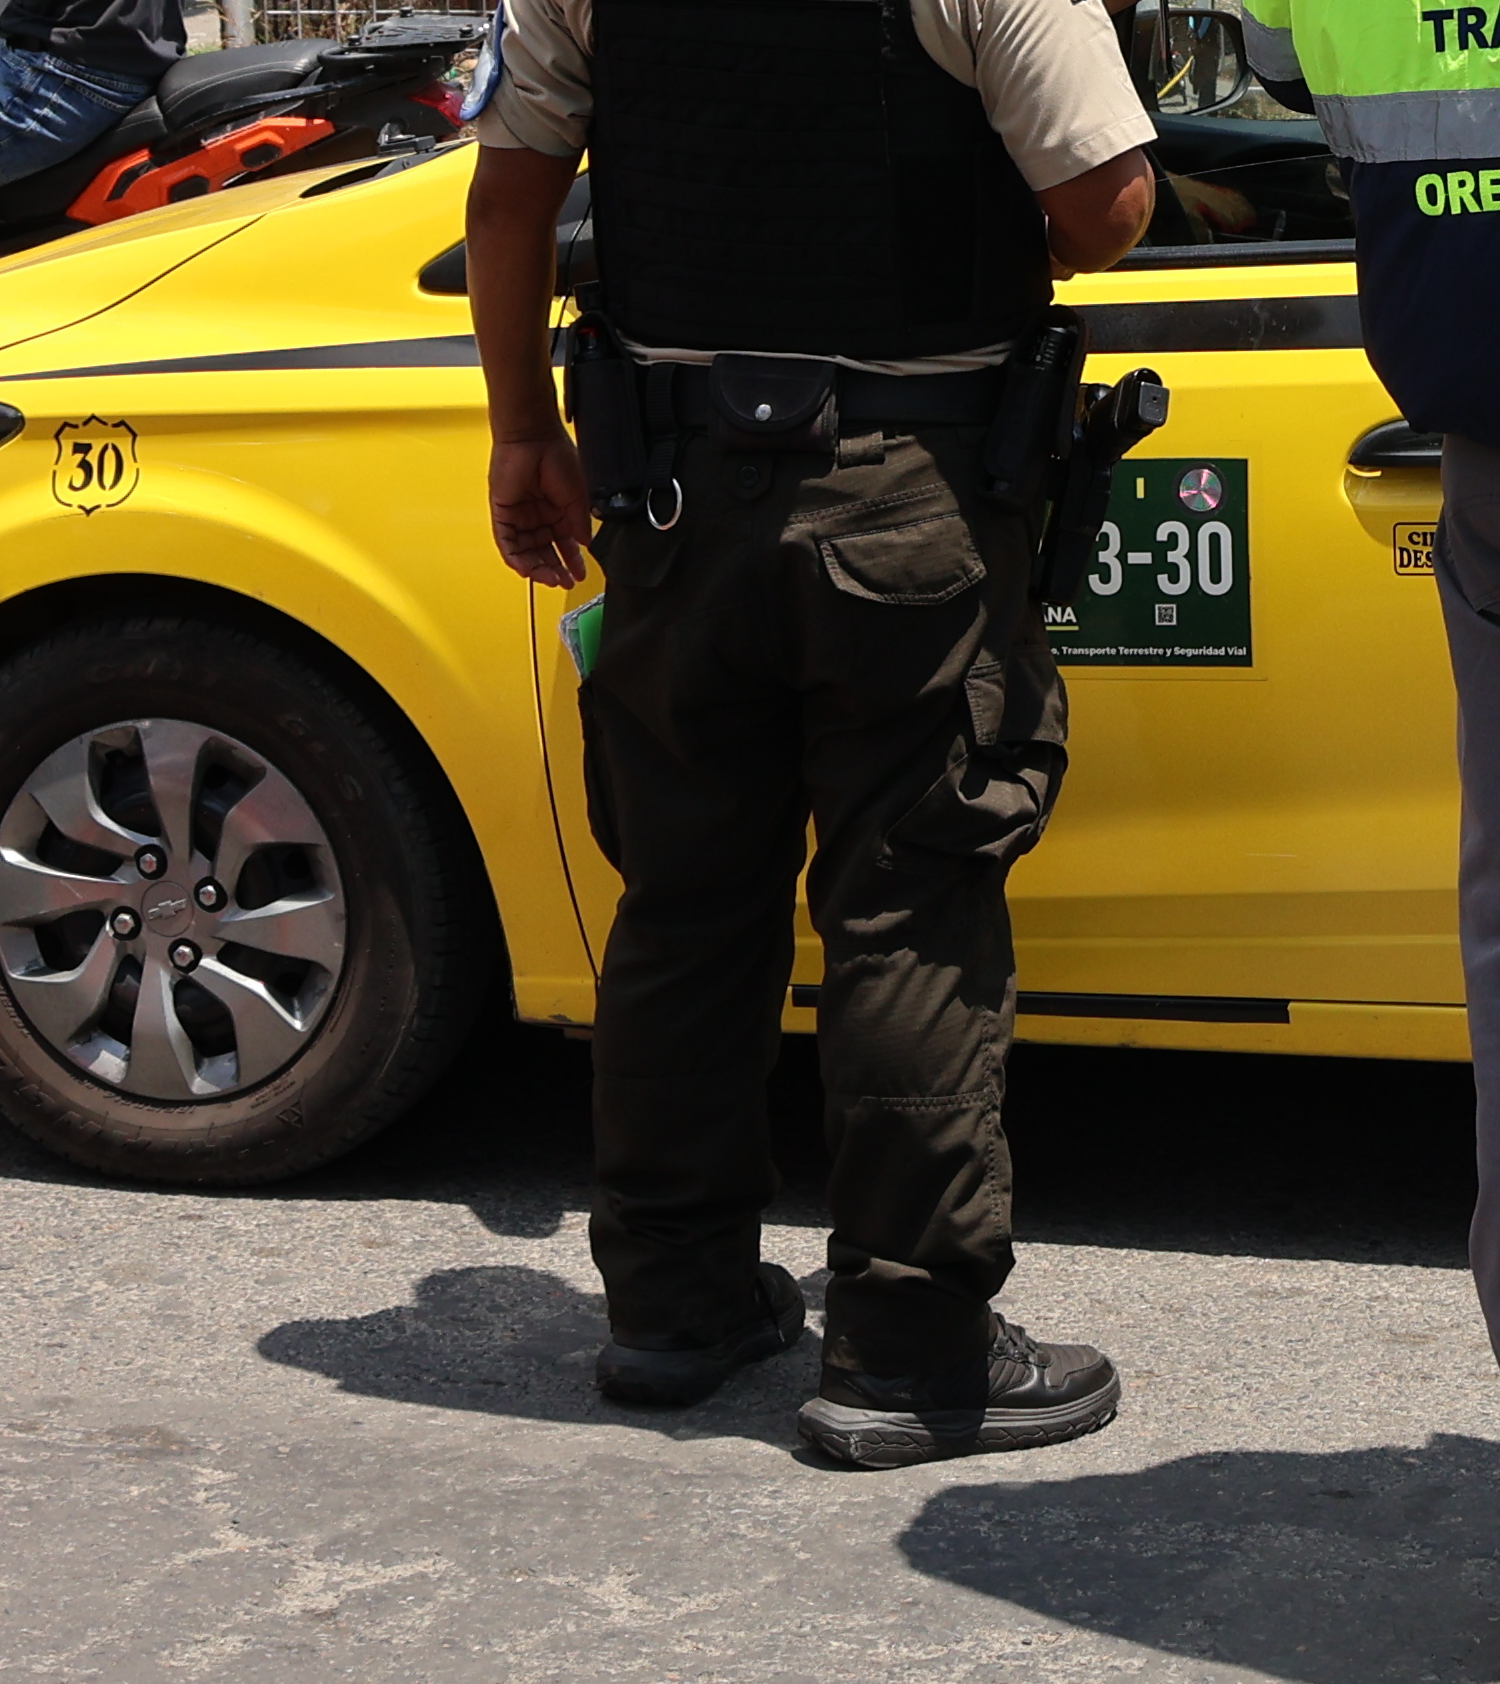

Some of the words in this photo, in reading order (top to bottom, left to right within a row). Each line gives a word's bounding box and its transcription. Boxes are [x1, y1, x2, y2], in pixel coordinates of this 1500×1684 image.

[68, 440, 124, 492] 30
[1062, 646, 1116, 657] Transporte
[1118, 646, 1164, 656] Terrestre
[1165, 648, 1172, 657] y
[1174, 646, 1225, 657] Seguridad
[1227, 646, 1247, 656] Vial
